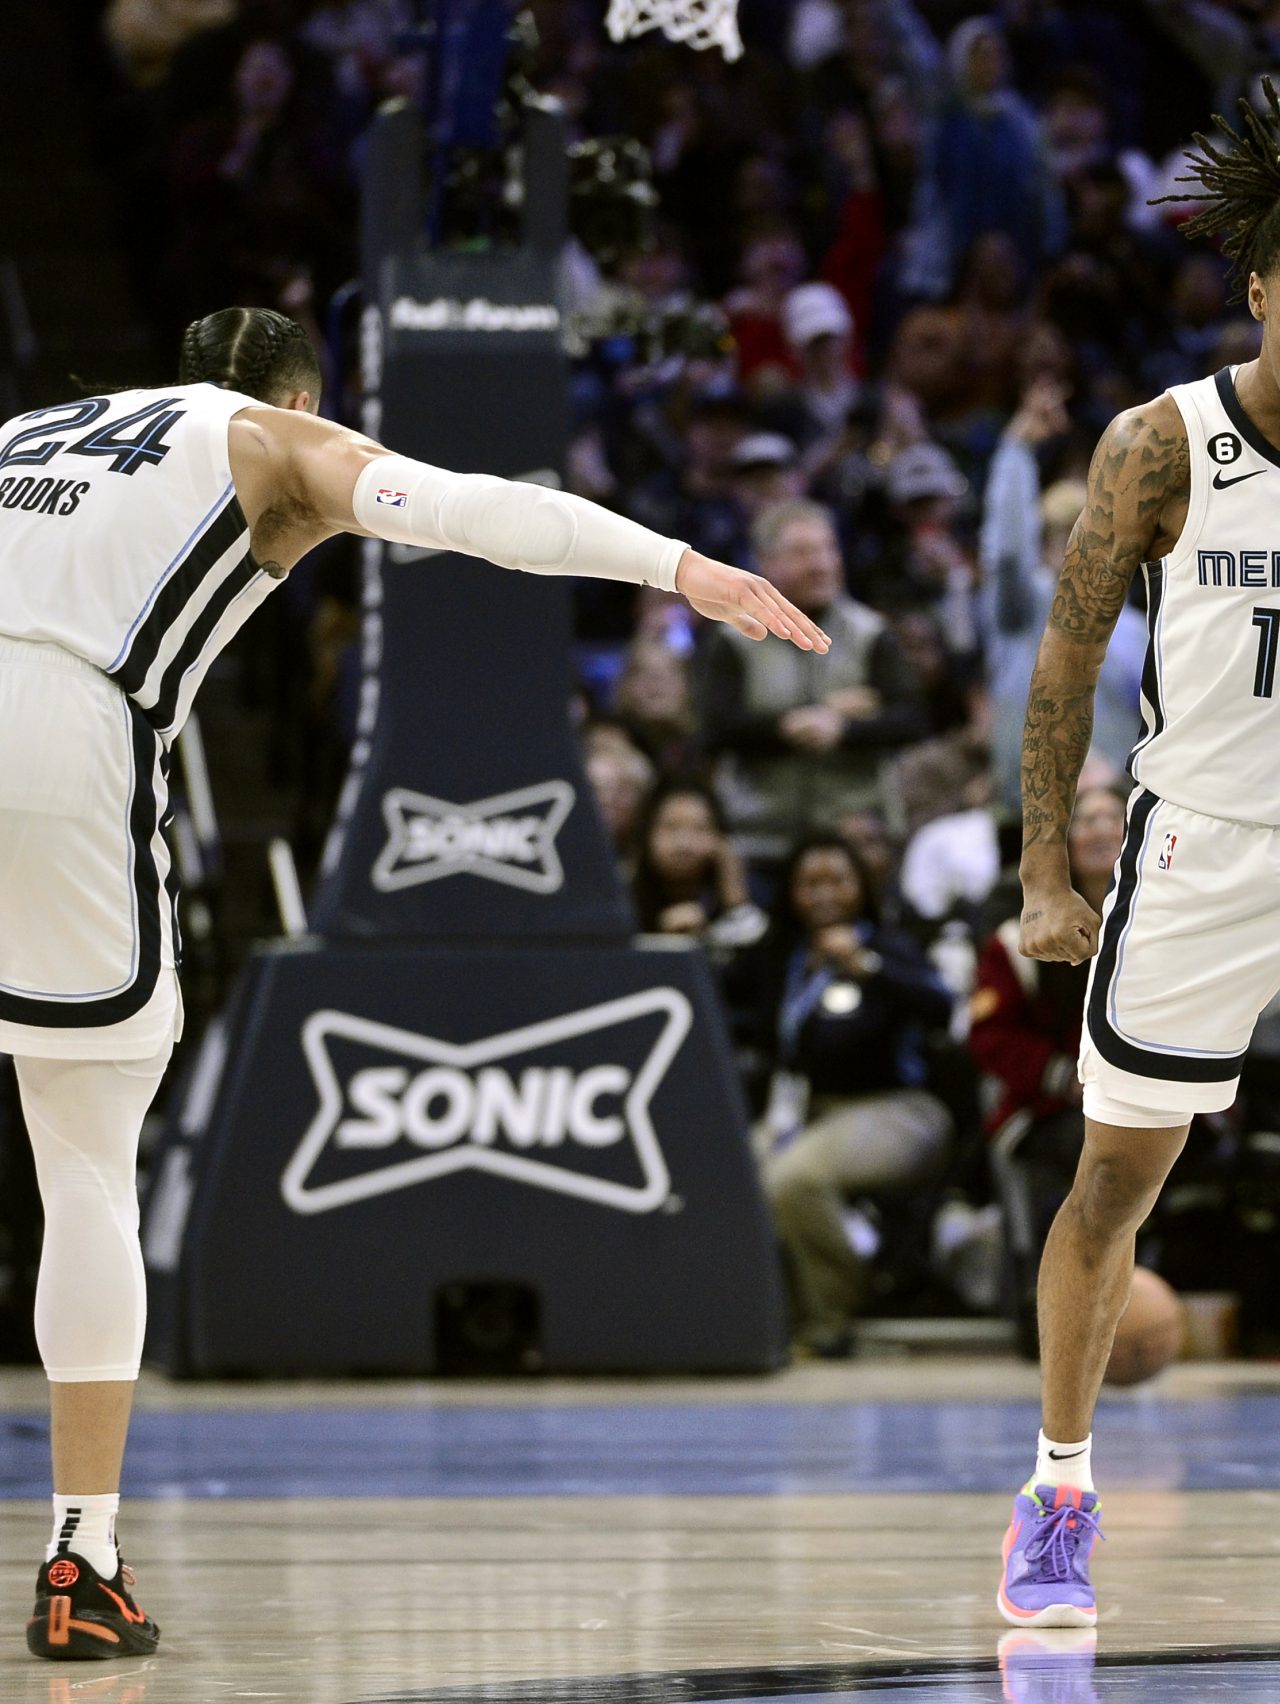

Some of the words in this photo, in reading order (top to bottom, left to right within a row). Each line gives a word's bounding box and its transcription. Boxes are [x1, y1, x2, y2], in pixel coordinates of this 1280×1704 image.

[0, 398, 188, 476] 24
[1215, 437, 1234, 462] 6
[335, 1064, 631, 1149] SONIC
